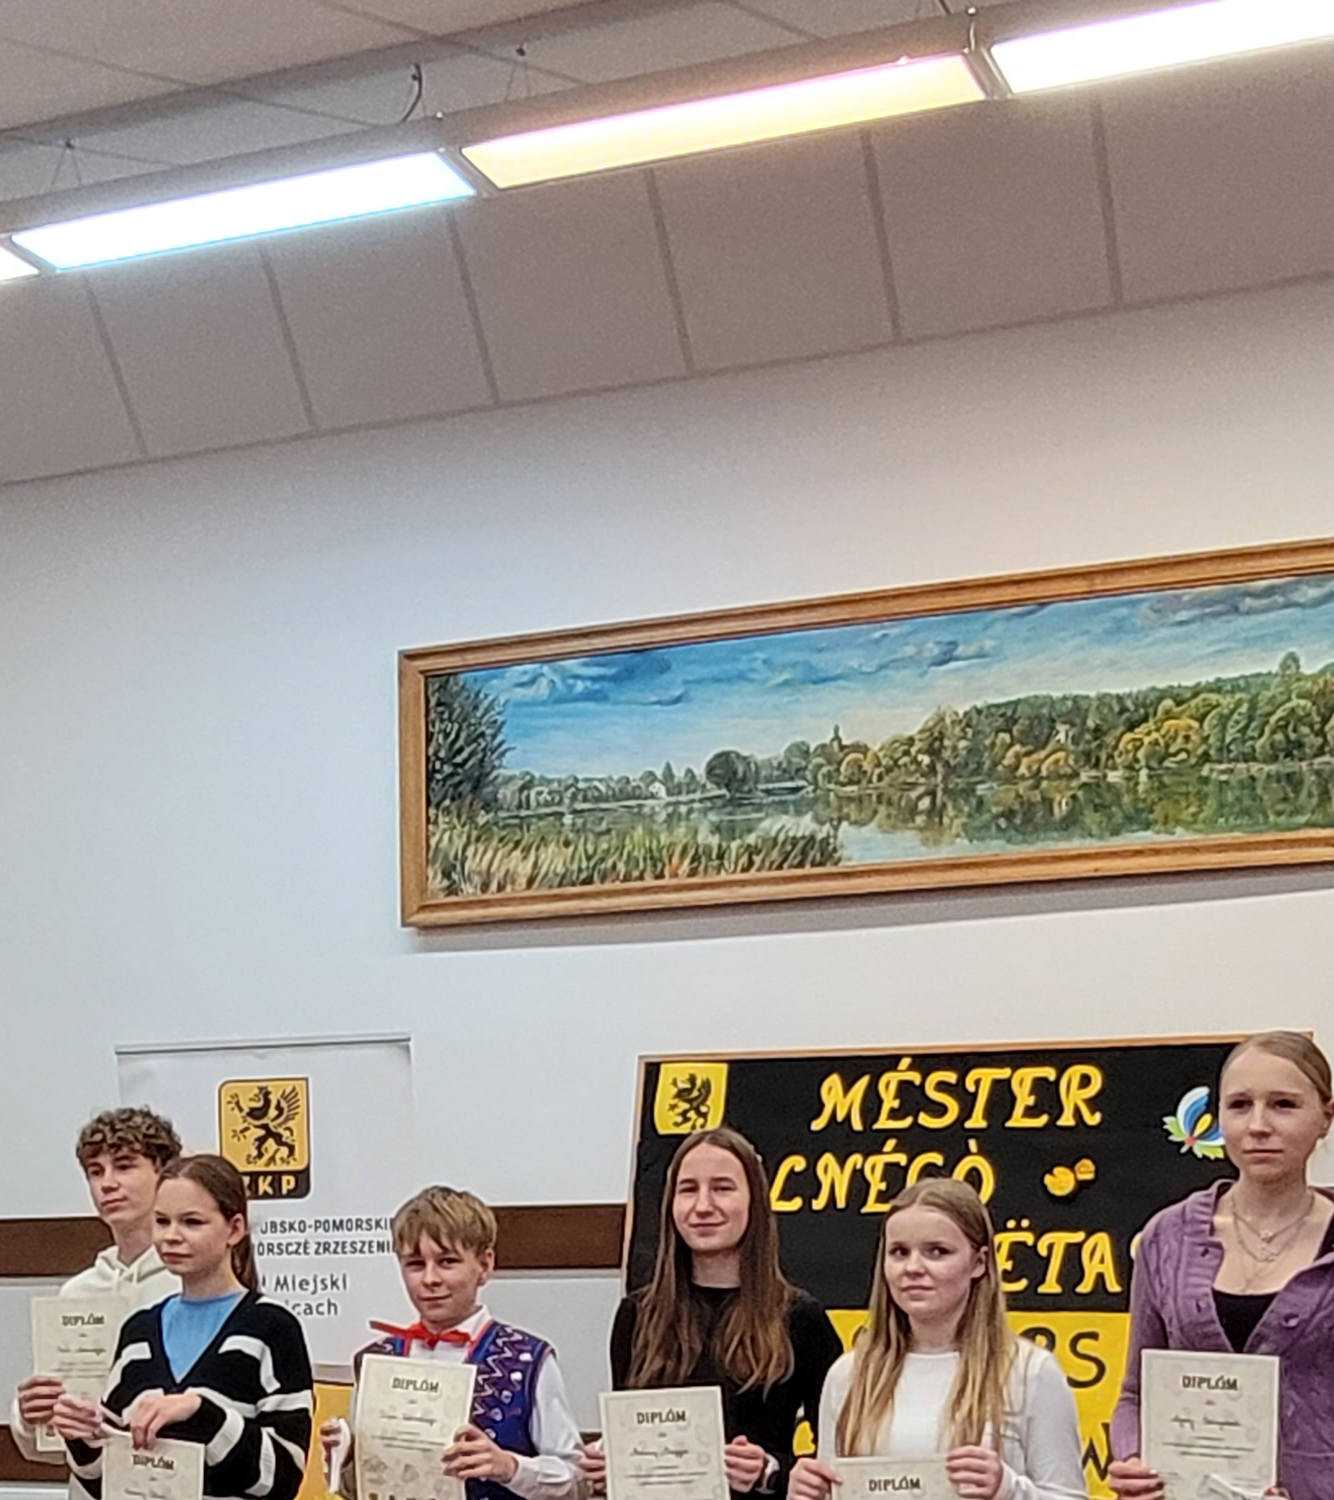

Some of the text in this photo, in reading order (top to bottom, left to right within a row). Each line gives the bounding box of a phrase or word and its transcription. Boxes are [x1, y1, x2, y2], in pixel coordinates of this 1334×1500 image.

[810, 1057, 1102, 1131] MÉSTER
[260, 1217, 393, 1234] UBSKO-POMORSKI
[993, 1219, 1139, 1293] ËTA
[274, 1273, 347, 1295] Miejski
[285, 1298, 338, 1316] cach
[392, 1377, 440, 1393] DIPLÓM
[1182, 1375, 1238, 1391] DIPLÓM
[636, 1408, 686, 1424] DIPLÓM
[869, 1475, 921, 1492] DIPLÓM
